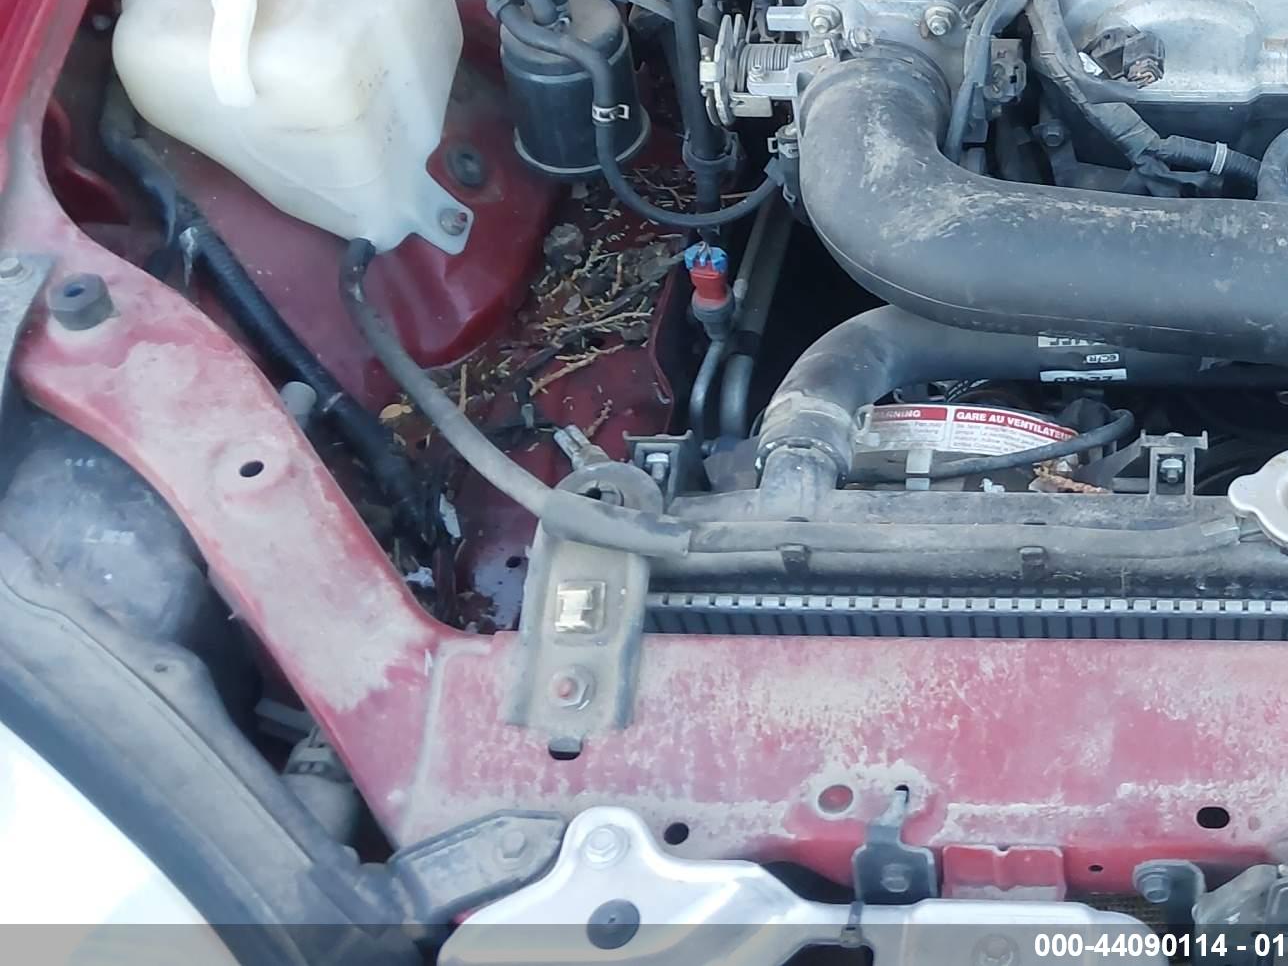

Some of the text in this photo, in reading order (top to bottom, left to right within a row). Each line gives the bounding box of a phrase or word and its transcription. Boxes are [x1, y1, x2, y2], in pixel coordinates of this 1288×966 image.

[872, 409, 922, 419] ARNING
[956, 411, 987, 422] GARE
[989, 414, 1005, 424] AU
